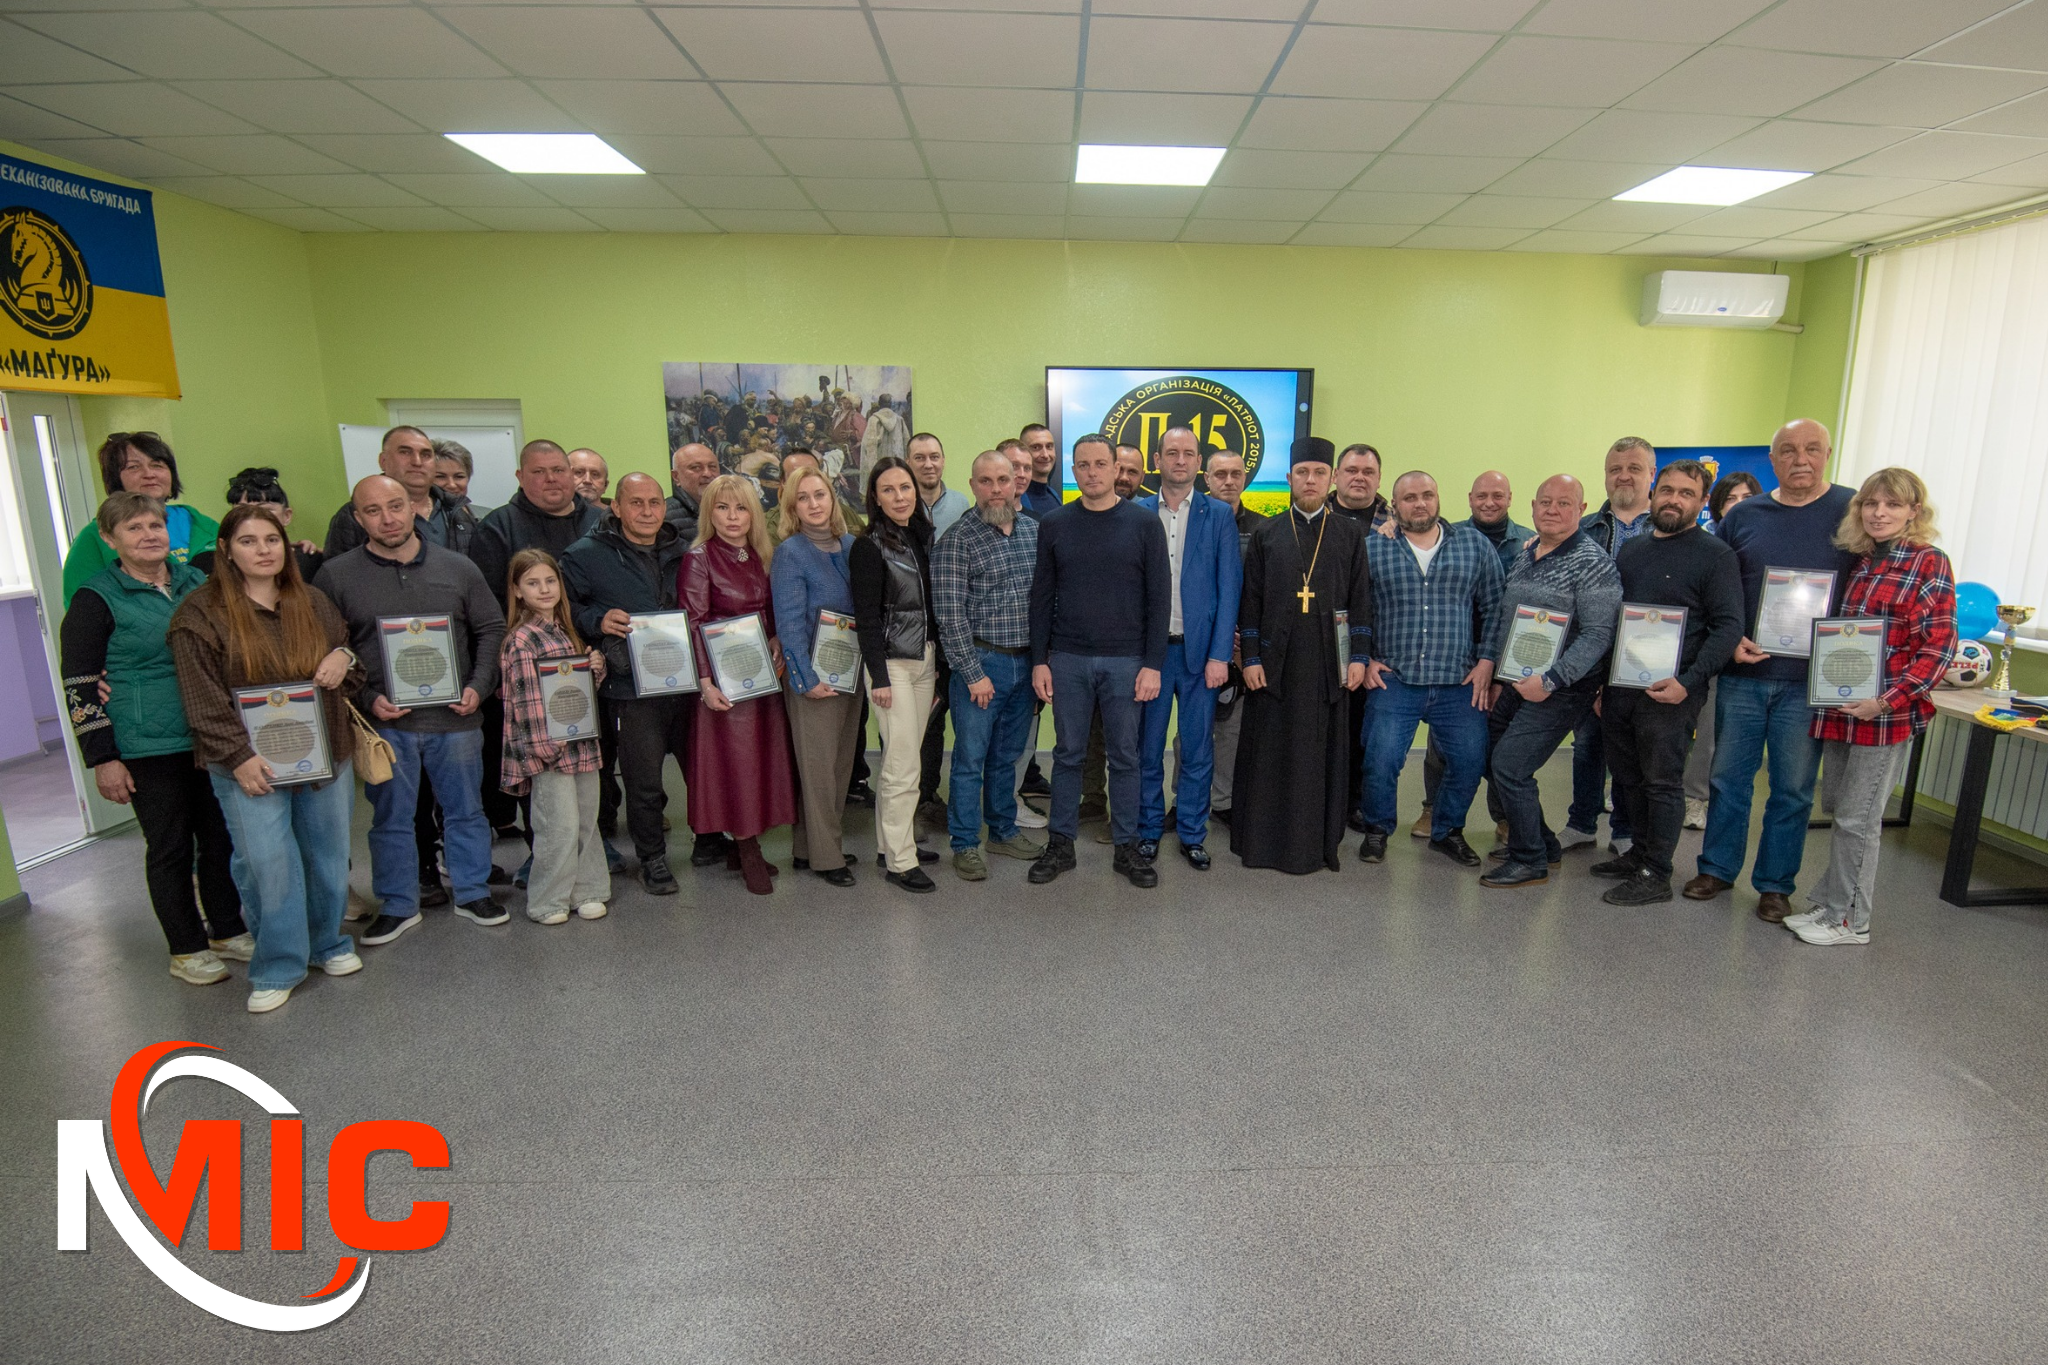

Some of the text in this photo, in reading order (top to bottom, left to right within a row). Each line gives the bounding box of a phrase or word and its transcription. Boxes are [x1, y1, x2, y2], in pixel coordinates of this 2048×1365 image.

[0, 163, 141, 215] ЕХАНІЗОВАНА БРИГАДА
[0, 347, 111, 383] «МАҐУРА»
[1136, 379, 1222, 399] ОРГАНІЗАЦІЯ
[1223, 393, 1260, 440] «ПАТРІОТ
[1245, 442, 1260, 473] 2015»
